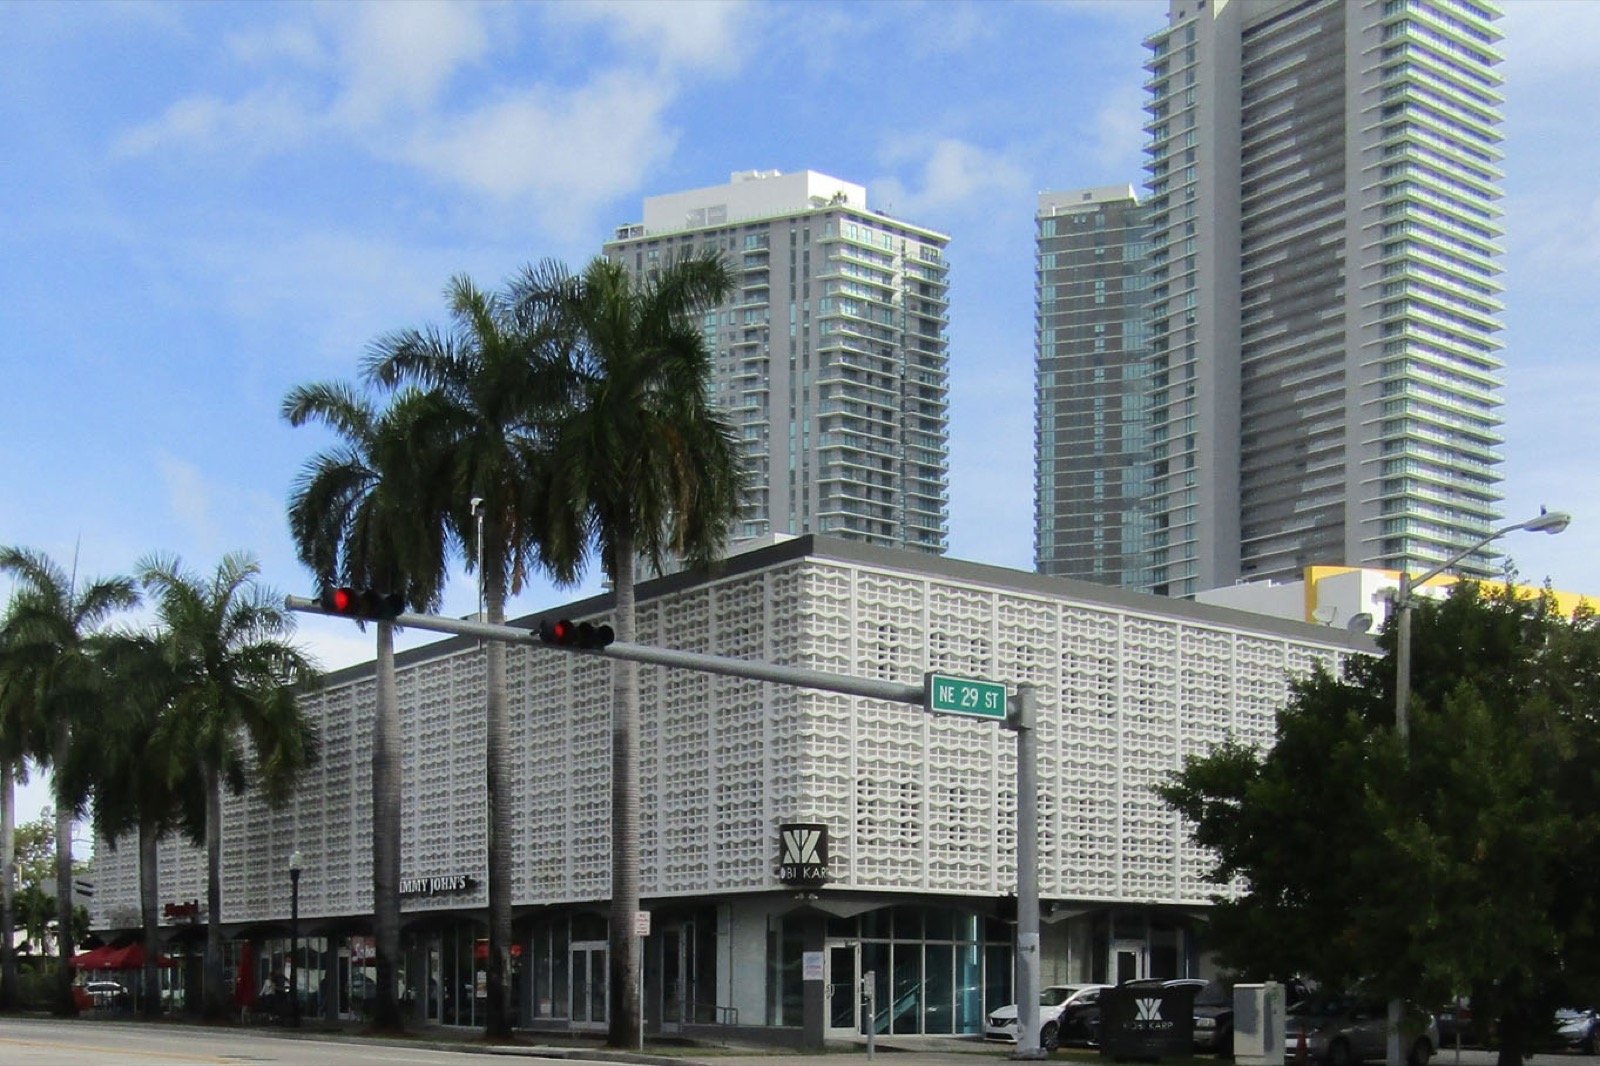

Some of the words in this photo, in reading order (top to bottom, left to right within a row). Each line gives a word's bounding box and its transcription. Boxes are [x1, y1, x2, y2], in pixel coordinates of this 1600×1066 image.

[939, 685, 955, 704] NE
[961, 686, 979, 708] 29
[985, 691, 999, 709] ST
[780, 867, 797, 880] OBI
[803, 866, 828, 879] KAR
[399, 877, 428, 893] IMMY
[430, 875, 466, 895] JOHN'S
